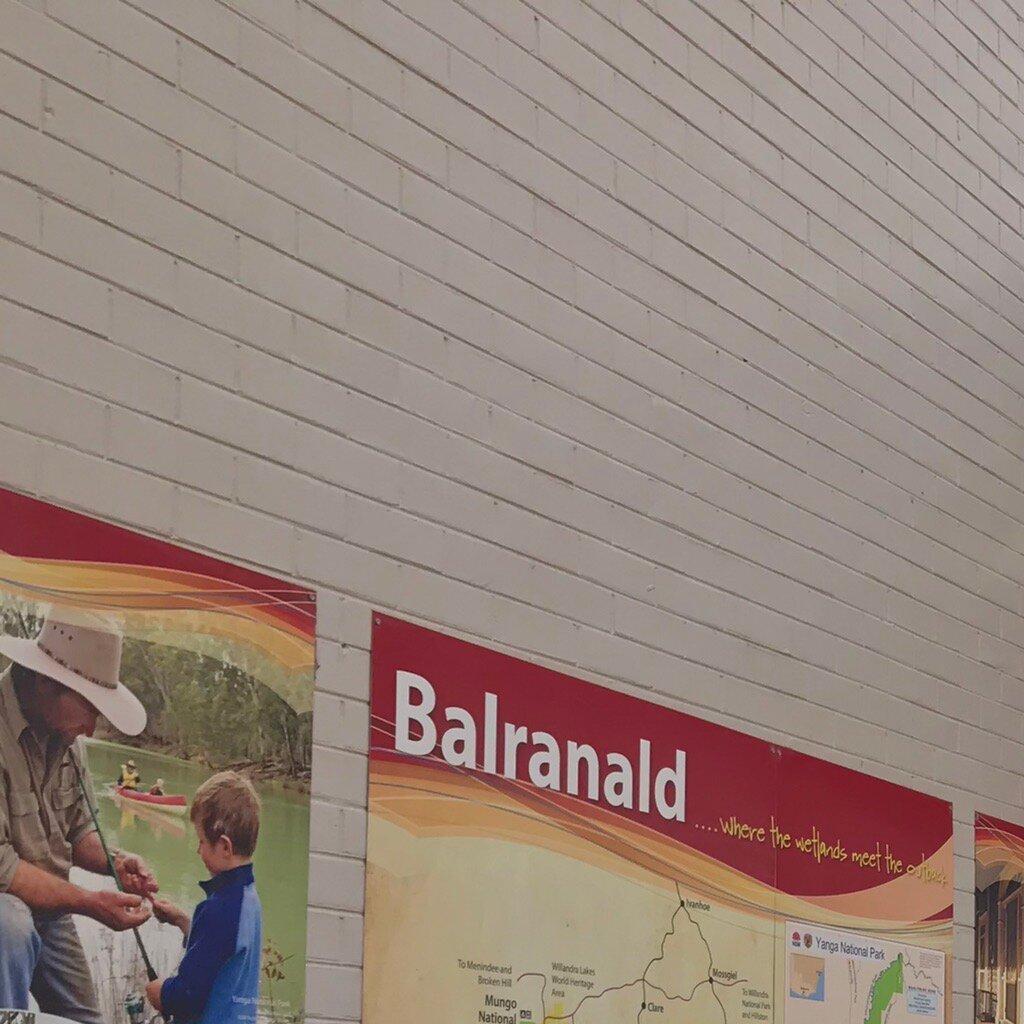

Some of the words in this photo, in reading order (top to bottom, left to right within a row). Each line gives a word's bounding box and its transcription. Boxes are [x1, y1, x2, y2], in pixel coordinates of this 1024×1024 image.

[394, 670, 688, 822] Balranald
[771, 816, 790, 849] the
[795, 826, 848, 863] wetlands
[852, 842, 882, 871] meet
[885, 844, 903, 874] the
[816, 936, 838, 954] Yanga
[840, 941, 868, 957] National
[869, 946, 886, 960] Park
[484, 995, 517, 1011] Mungo
[648, 1003, 664, 1013] Clare
